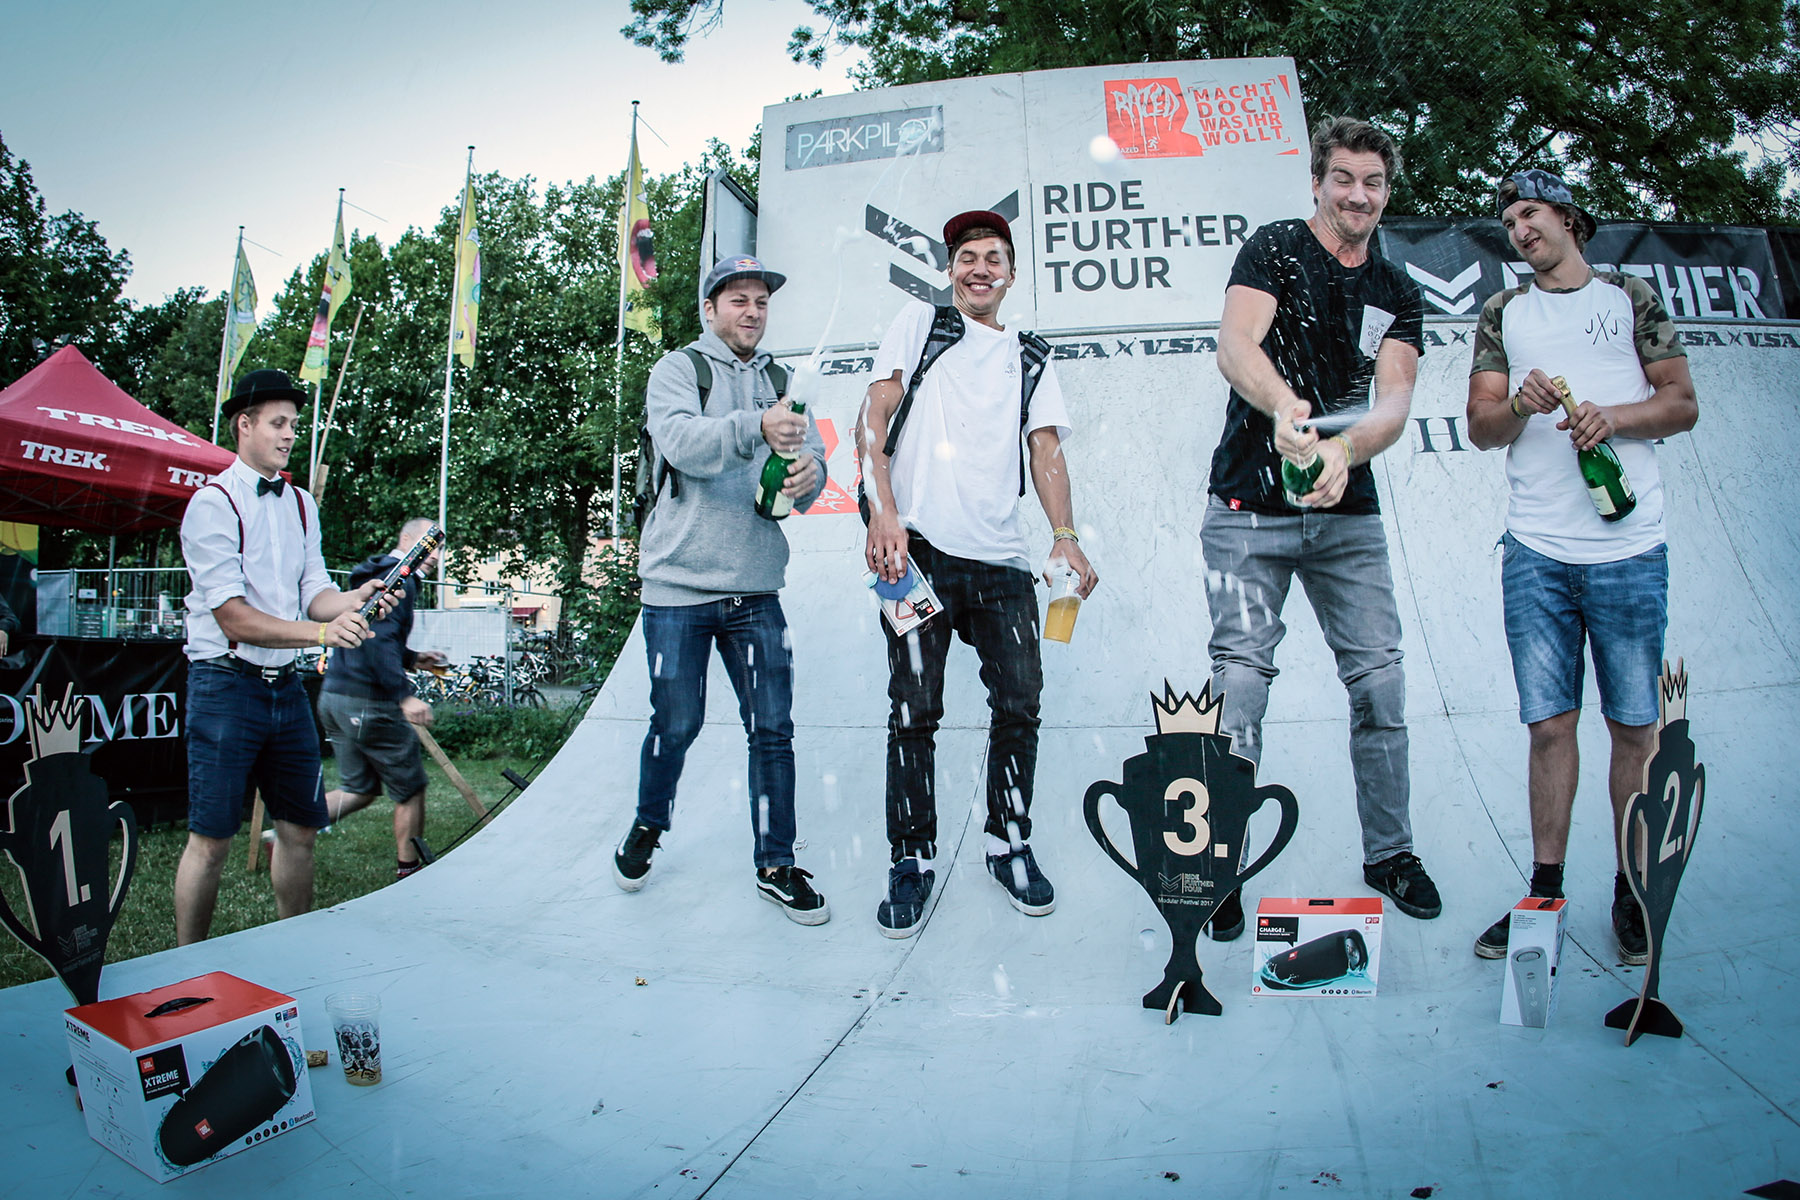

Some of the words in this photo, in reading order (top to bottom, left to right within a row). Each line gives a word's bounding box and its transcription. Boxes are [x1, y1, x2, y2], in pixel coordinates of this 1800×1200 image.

[1193, 83, 1271, 102] MACHT
[1196, 96, 1278, 119] DOCH
[1199, 116, 1243, 131] WAS
[1247, 112, 1283, 128] IHR
[1202, 126, 1283, 146] WOLLT
[1043, 180, 1145, 215] RIDE
[1045, 214, 1249, 253] FURTHER
[1044, 256, 1172, 293] TOUR
[36, 406, 195, 447] TREK
[20, 440, 107, 471] TREK
[1163, 777, 1228, 856] 3.
[1658, 770, 1683, 864] 2.
[49, 809, 92, 908] 1.
[1184, 880, 1214, 888] FURTHER
[1158, 897, 1179, 905] Modular
[1180, 898, 1200, 906] Festival
[65, 1019, 90, 1042] XTREME
[144, 1069, 179, 1088] XTREME
[294, 1110, 314, 1124] Bluetooth
